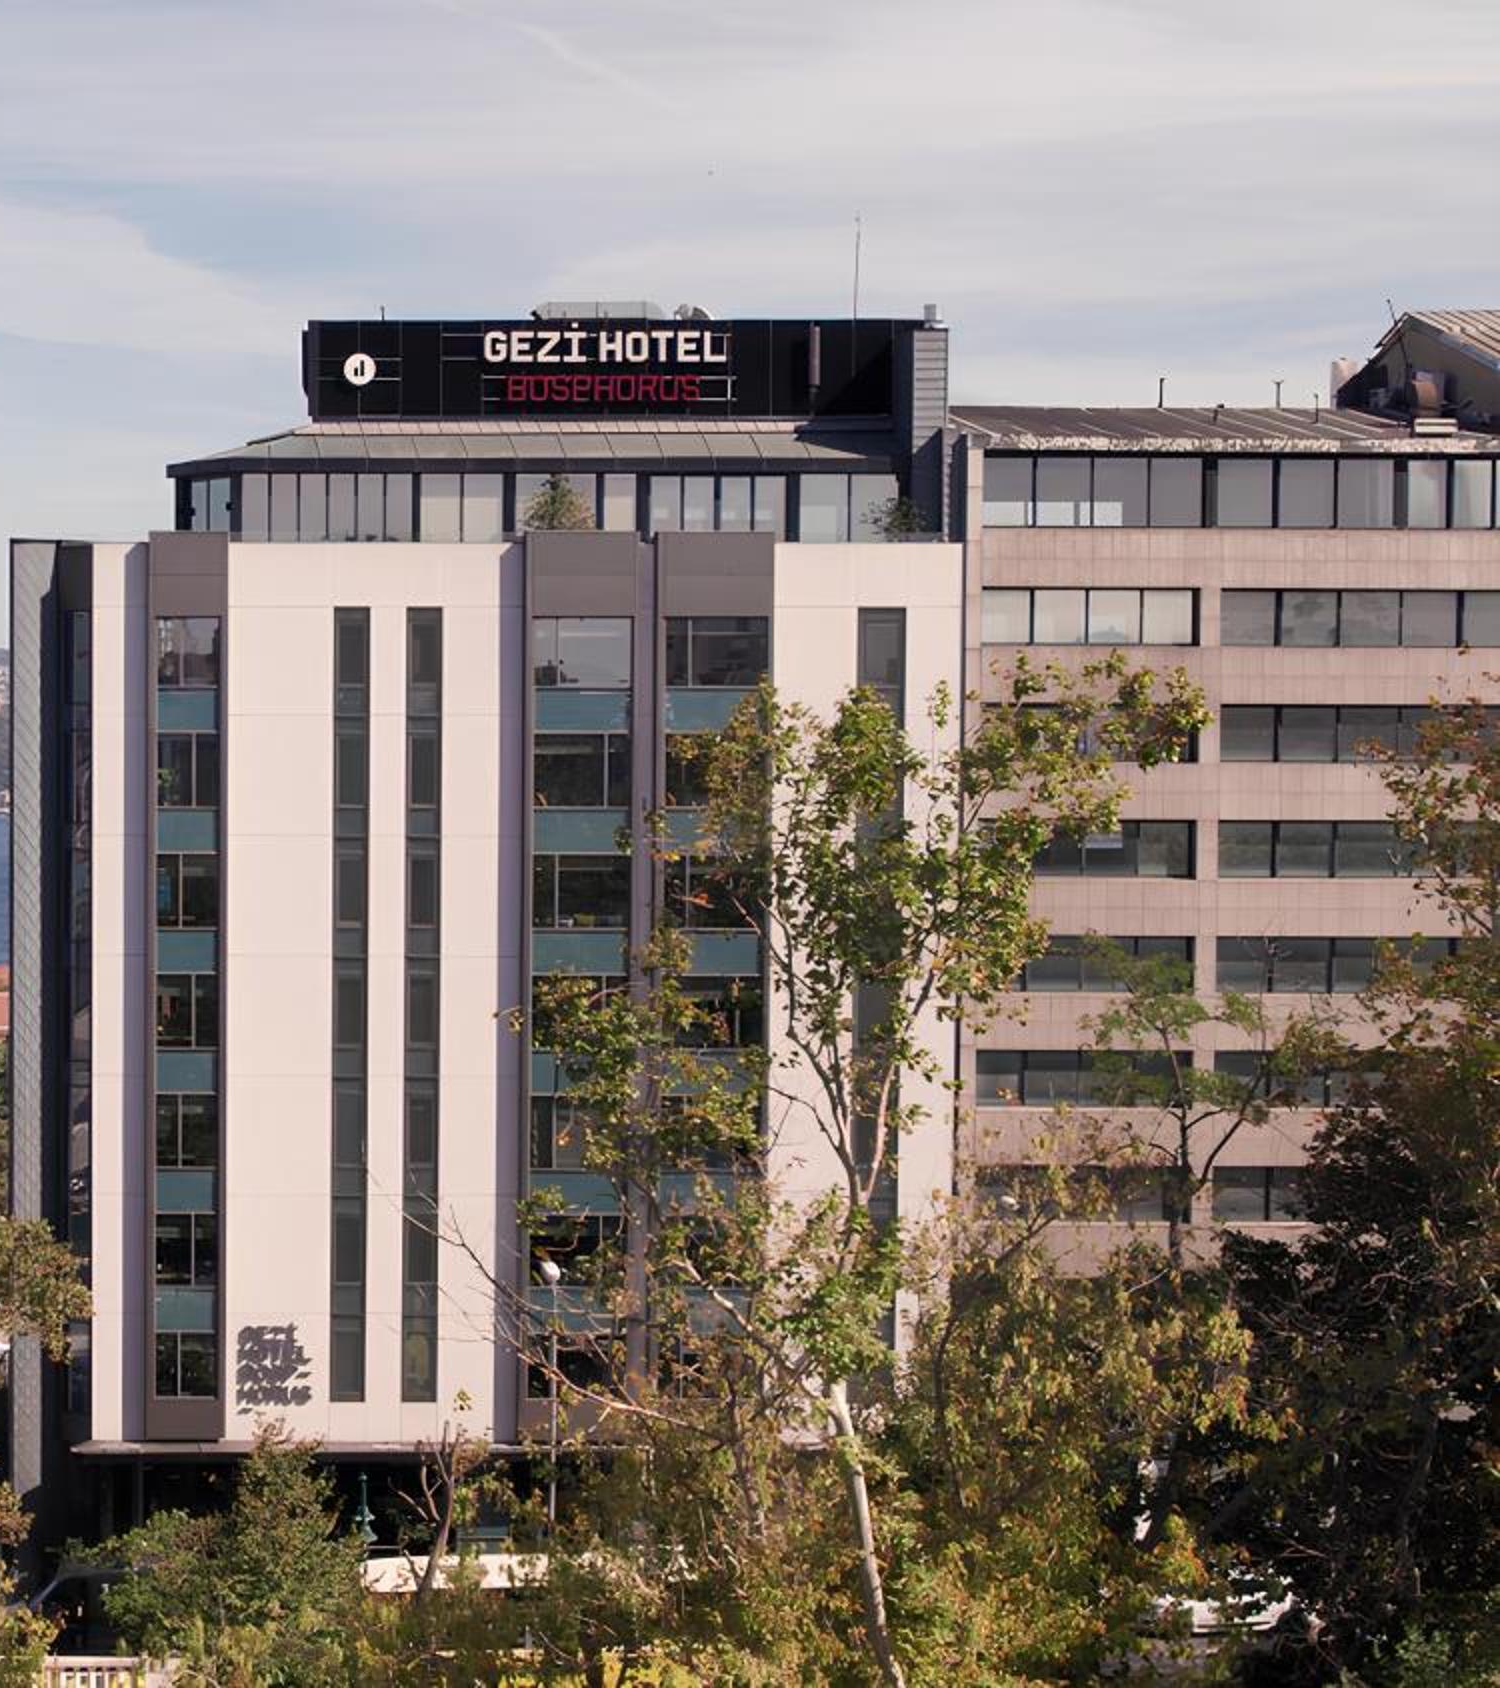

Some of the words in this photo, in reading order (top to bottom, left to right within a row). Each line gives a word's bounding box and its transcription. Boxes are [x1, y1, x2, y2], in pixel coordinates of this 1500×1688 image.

[483, 322, 587, 362] GEZİ
[599, 331, 727, 362] HOTEL
[506, 374, 700, 401] BOSPHORUS
